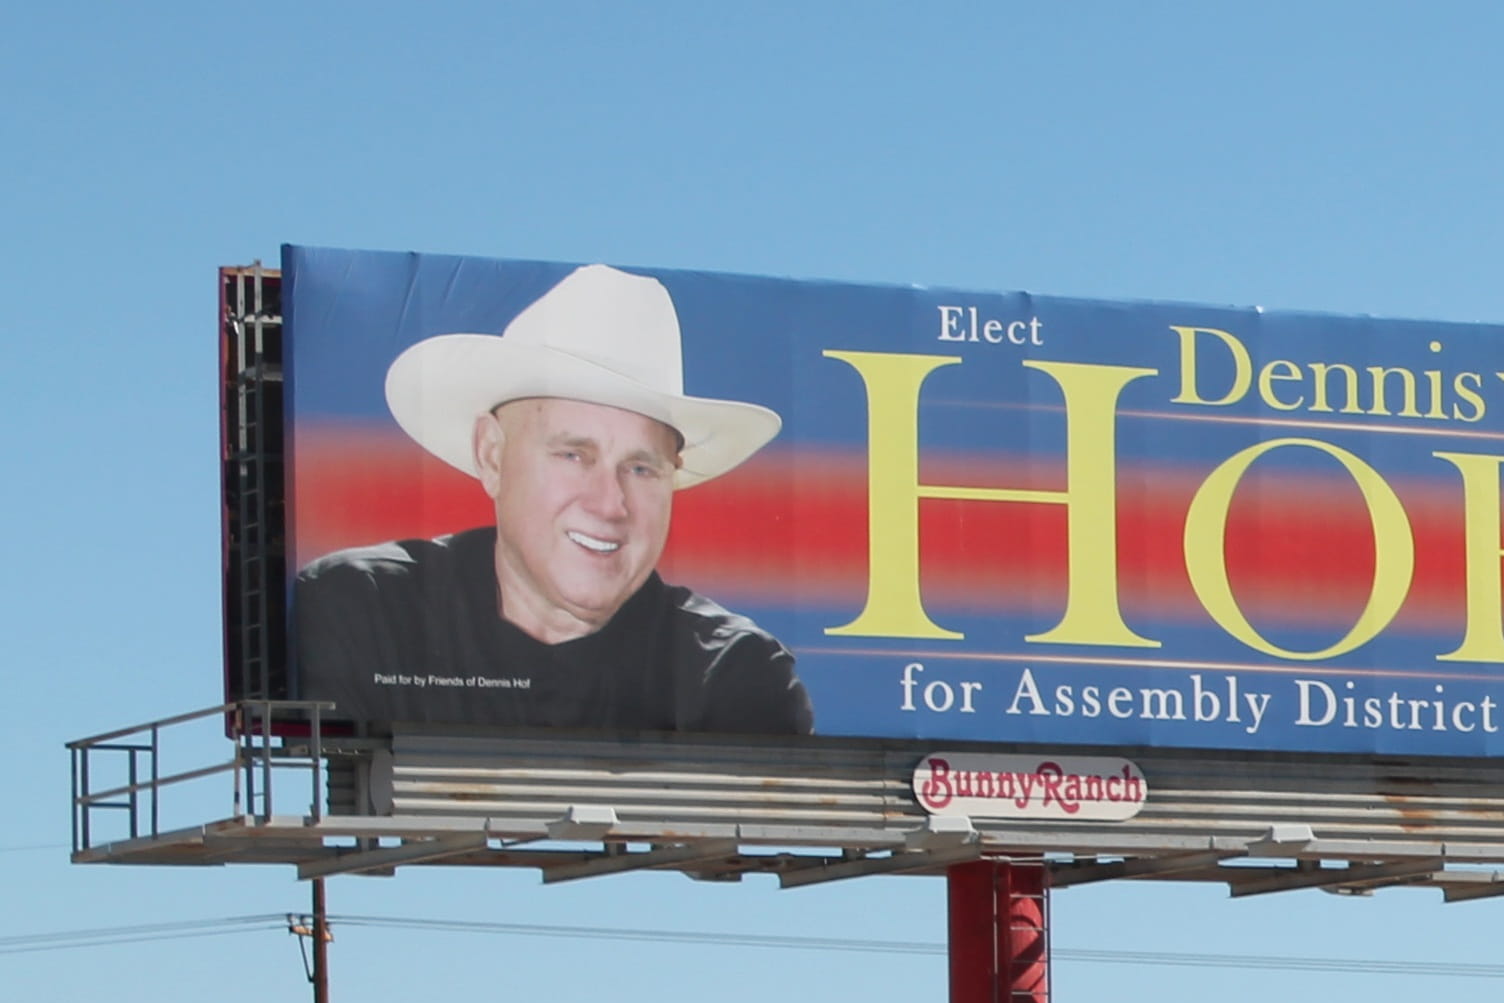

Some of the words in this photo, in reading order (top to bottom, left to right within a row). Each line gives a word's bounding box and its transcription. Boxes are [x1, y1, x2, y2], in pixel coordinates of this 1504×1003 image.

[936, 304, 1044, 346] Elect
[1168, 325, 1485, 422] Dennis
[374, 673, 397, 685] Paid
[399, 674, 412, 685] for
[414, 674, 426, 687] by
[428, 675, 464, 687] Friends
[466, 676, 476, 687] of
[477, 677, 511, 688] Dennis
[513, 678, 530, 689] Hof
[900, 663, 983, 713] for
[1006, 668, 1271, 734] Assembly
[1294, 679, 1498, 734] District
